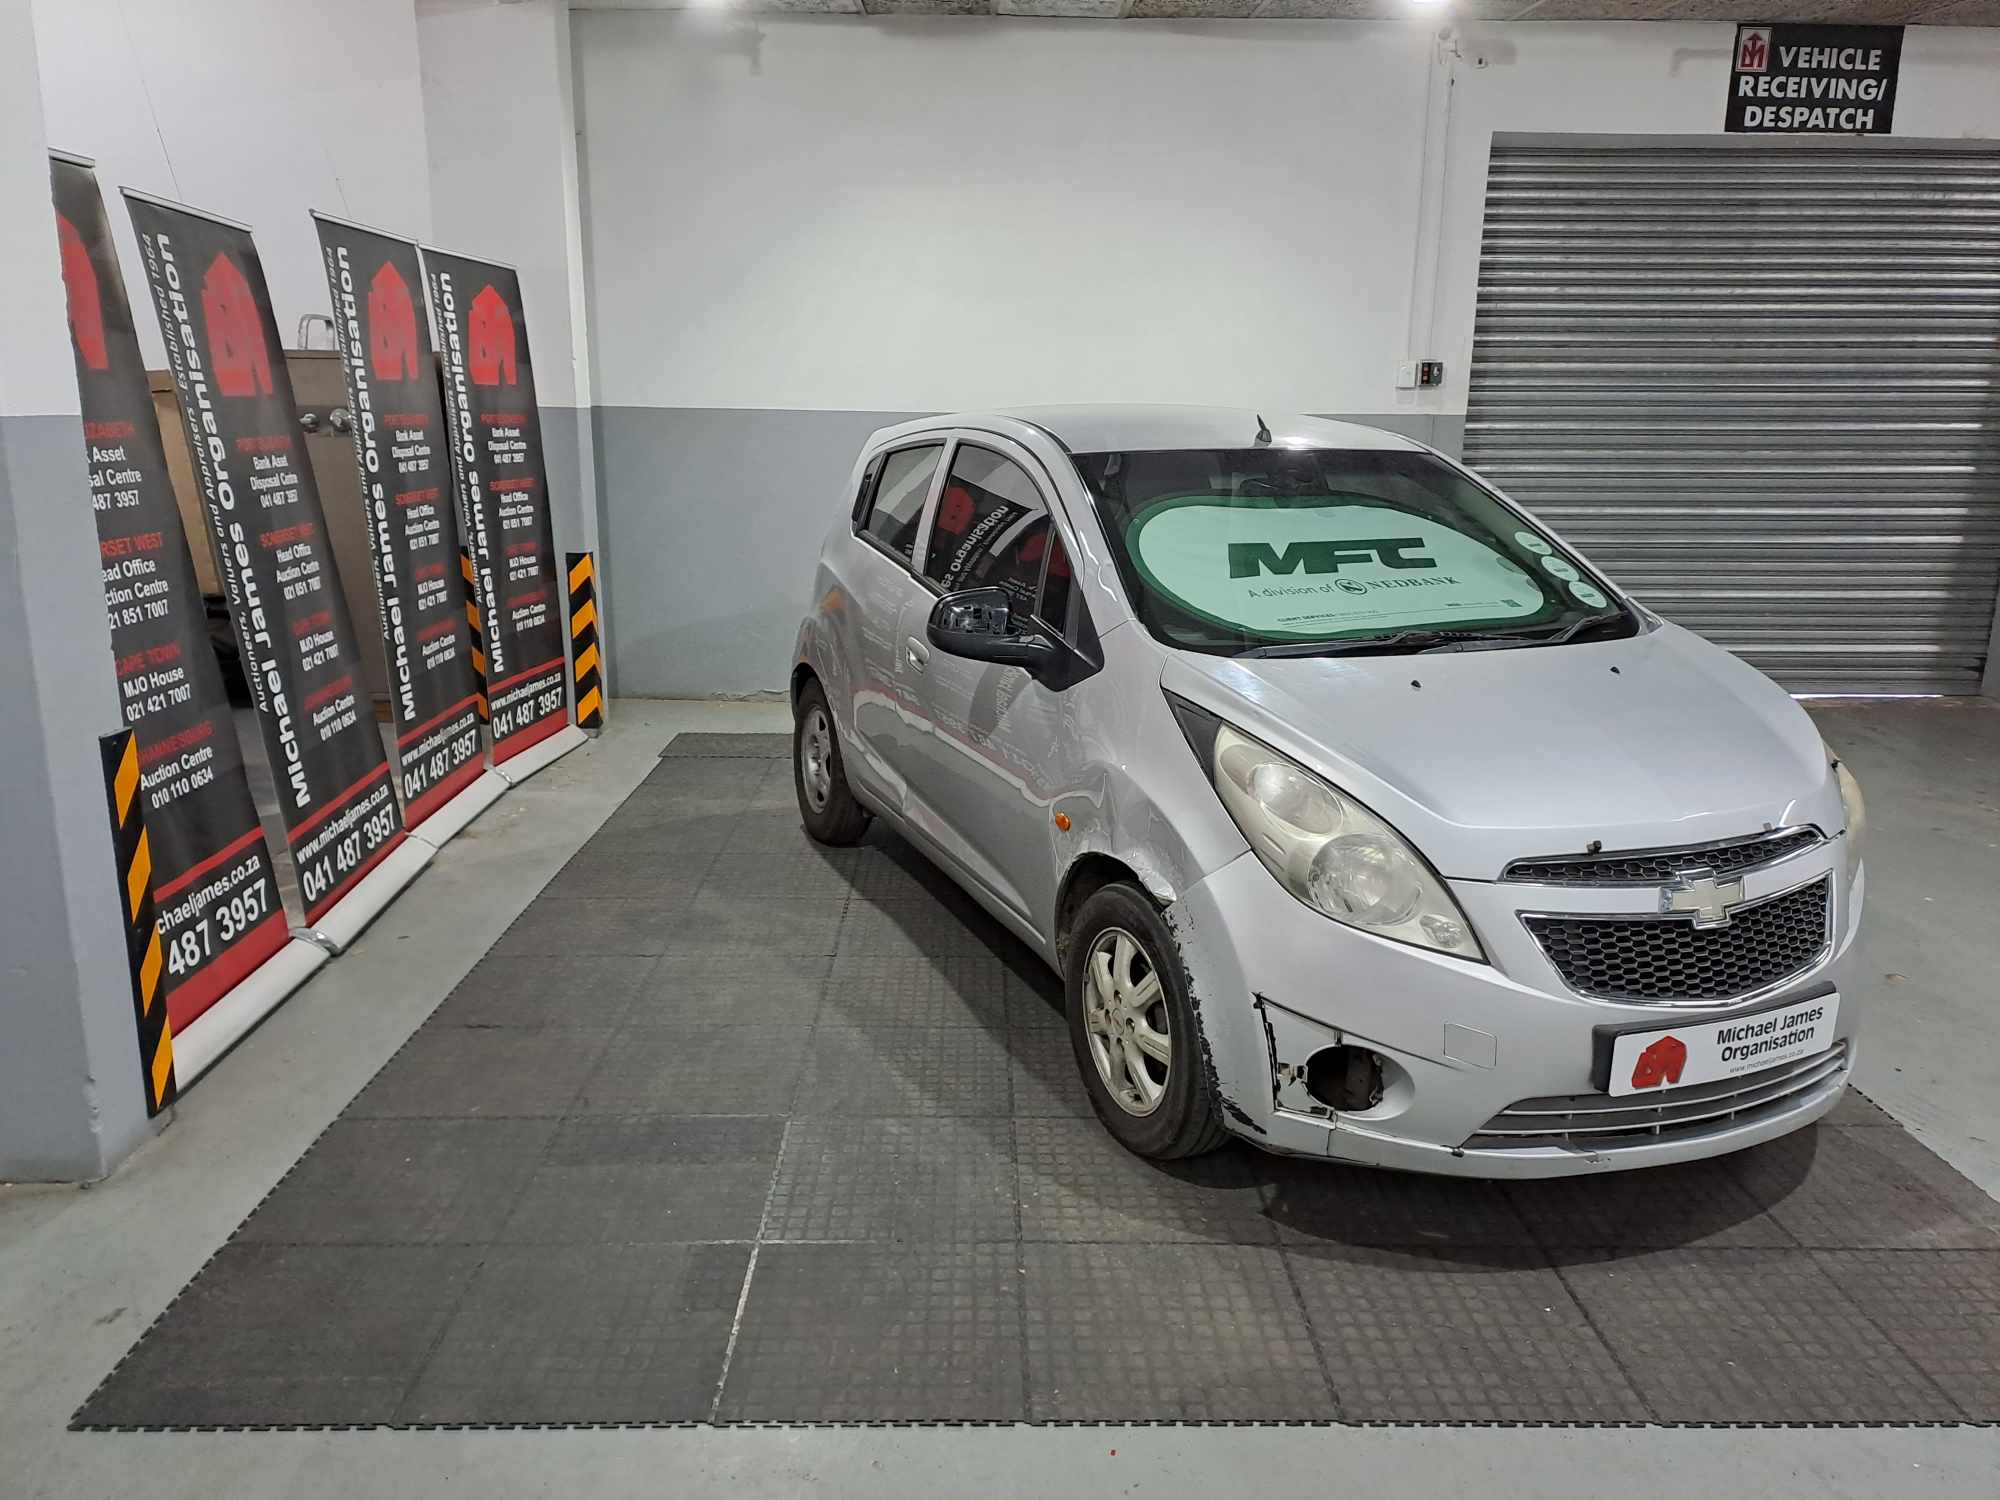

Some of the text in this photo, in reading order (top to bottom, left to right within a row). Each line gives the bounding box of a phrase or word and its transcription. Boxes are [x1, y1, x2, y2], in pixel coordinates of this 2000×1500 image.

[1779, 46, 1882, 71] VEHICLE
[1738, 76, 1887, 100] RECEIVING/
[1743, 106, 1874, 129] DESPATCH
[153, 283, 188, 390] Established
[93, 446, 126, 462] Asset
[187, 406, 216, 499] Appraisers
[106, 468, 142, 485] Centre
[337, 246, 416, 721] Michael James Organisation
[440, 272, 504, 673] Michael James Organisation
[91, 490, 139, 511] 487 3957
[156, 233, 310, 808] Michael James Organisation
[210, 506, 223, 537] and
[101, 537, 132, 556] RSET
[1228, 537, 1438, 579] MFC
[101, 559, 155, 582] ead Office
[221, 542, 240, 605] Valuers
[1248, 575, 1462, 599] A division of NEDBANK
[105, 579, 168, 605] ction Centre
[108, 599, 168, 629] 21 851 7007
[124, 666, 184, 698] MJO House
[127, 684, 191, 721] 021 421 7007
[493, 687, 562, 739] 041 487 3957
[140, 746, 213, 791] Auction Centre
[404, 729, 476, 798] 041 487 3957
[152, 766, 214, 808] 010 110 0634
[303, 803, 395, 902] 041 487 3957
[168, 878, 267, 975] 487 3957
[1717, 1007, 1823, 1044] Michael James
[1721, 1027, 1814, 1061] Organisation
